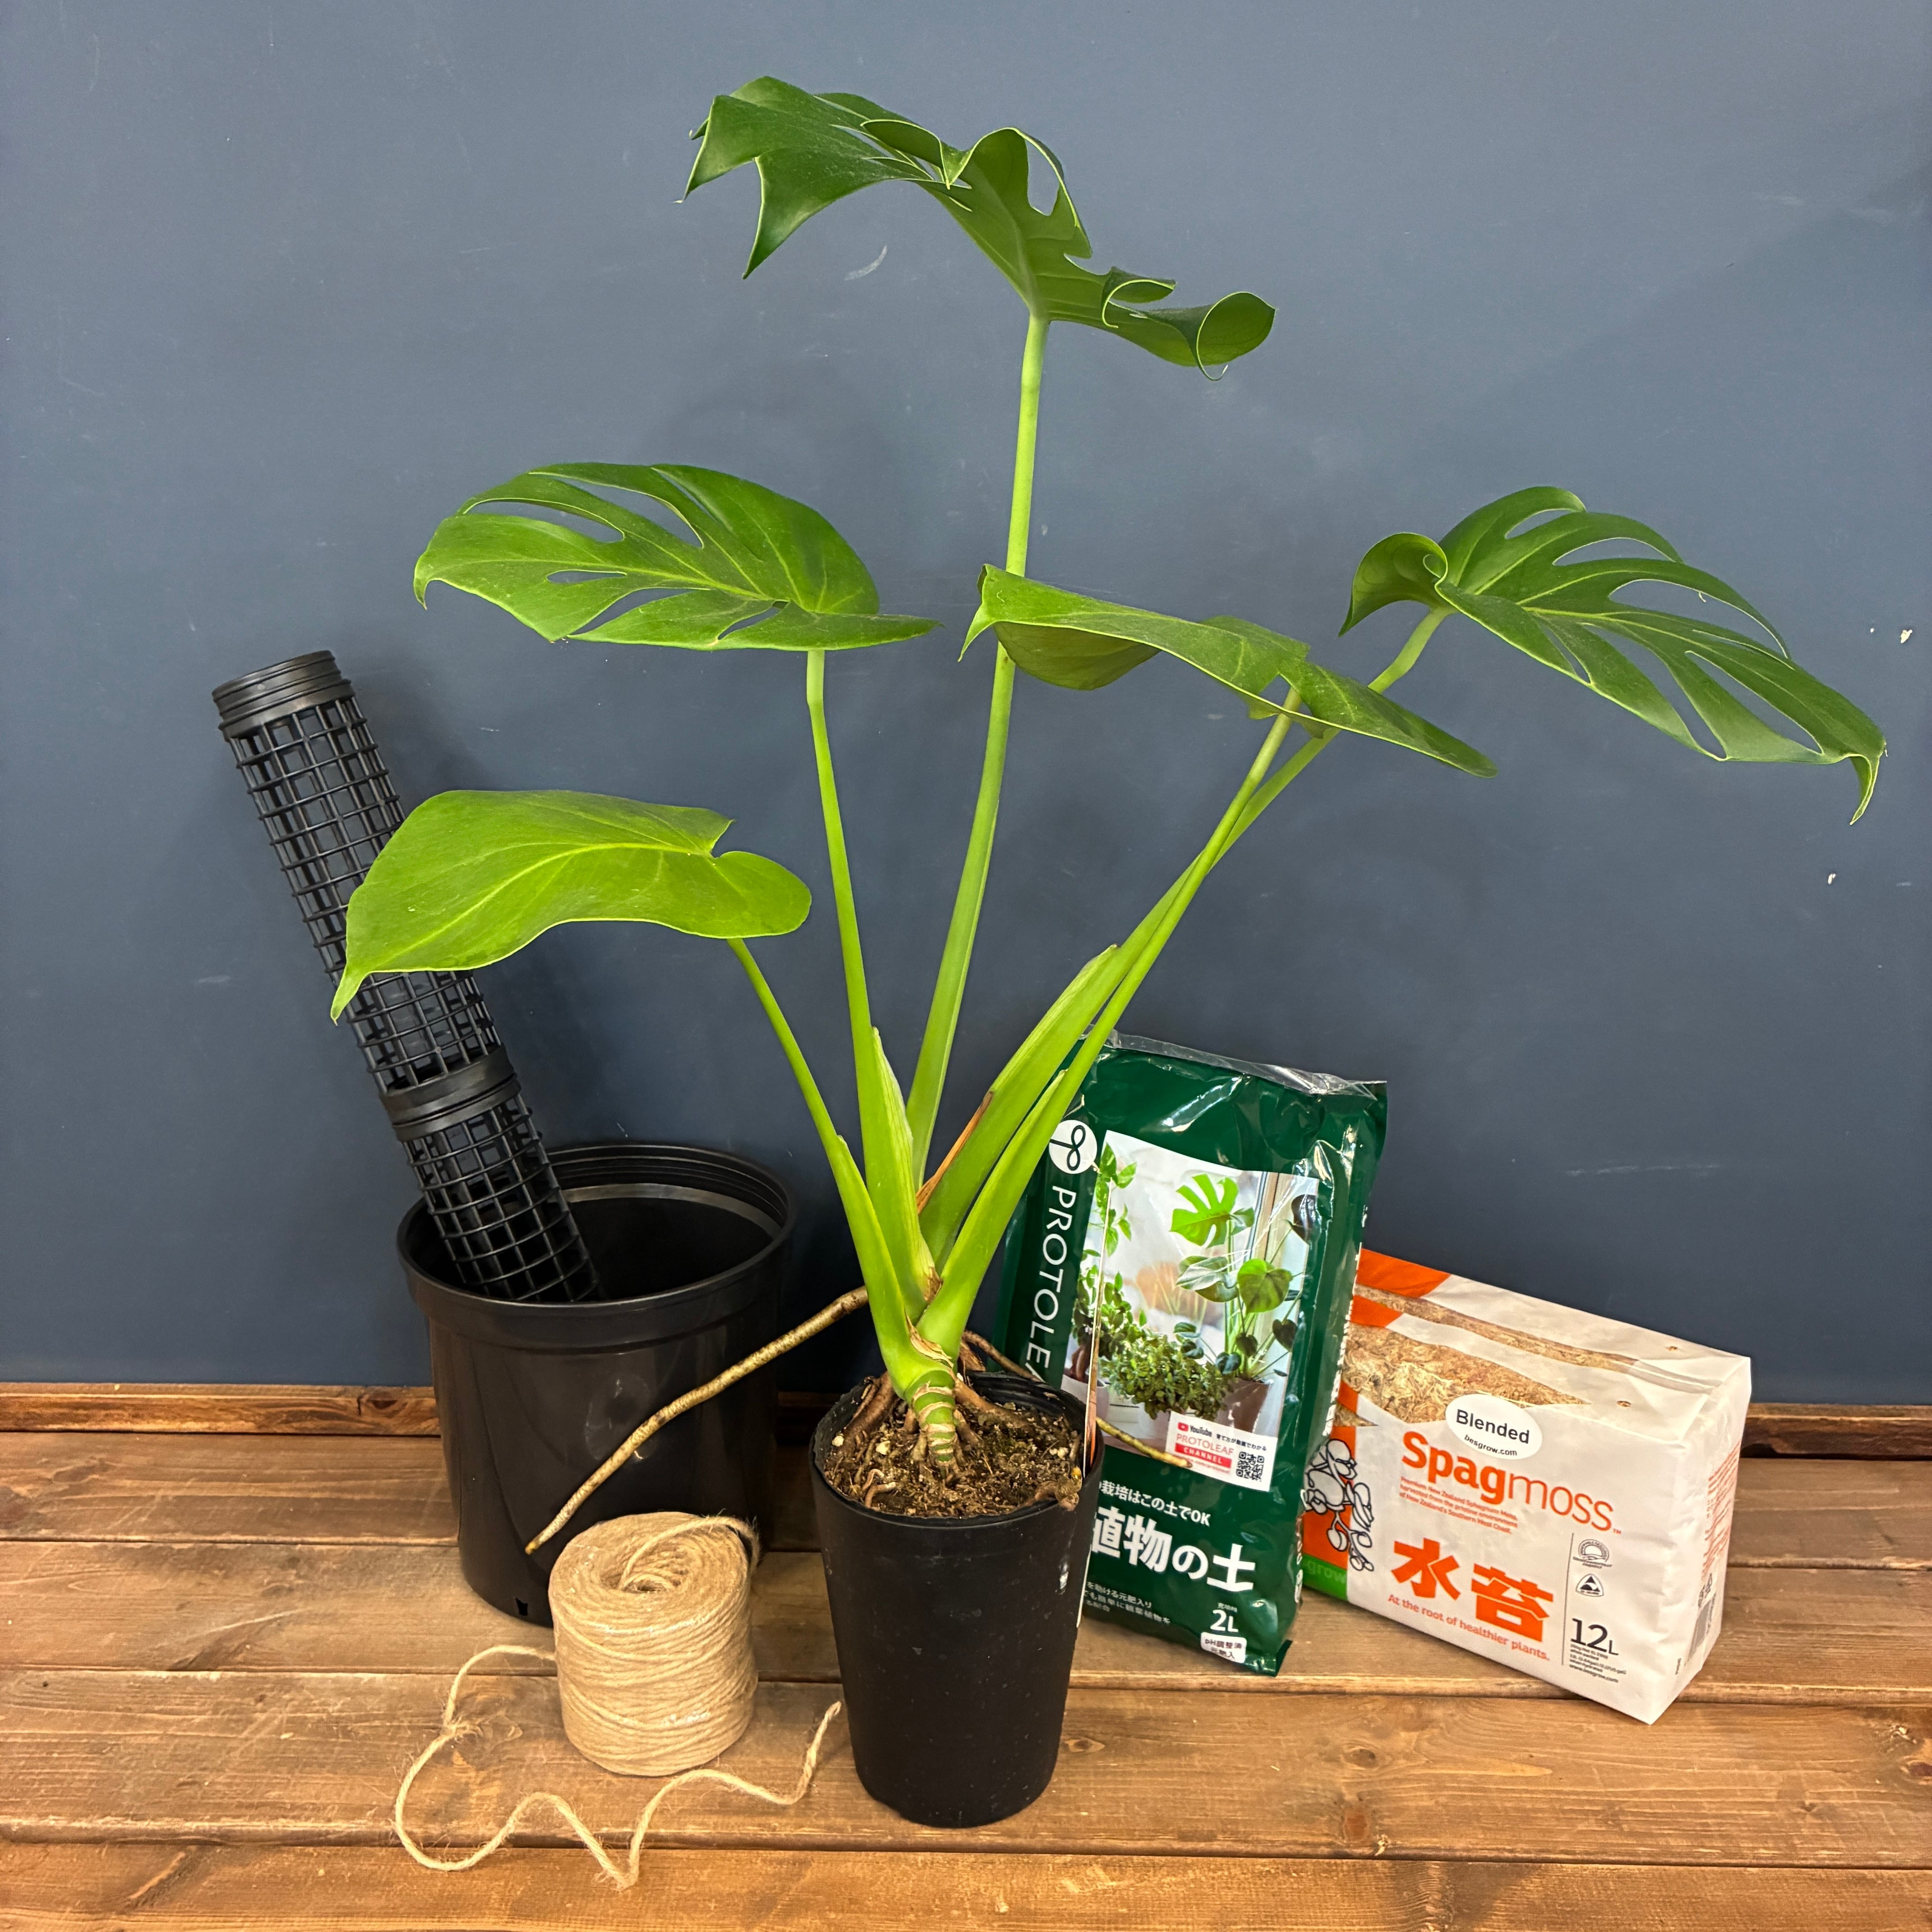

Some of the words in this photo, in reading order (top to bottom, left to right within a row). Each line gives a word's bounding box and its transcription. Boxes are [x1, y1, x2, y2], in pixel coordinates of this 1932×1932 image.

[1177, 1433, 1234, 1455] PROTOLEAF
[1190, 1425, 1212, 1437] YouTube
[1456, 1409, 1529, 1444] Blended
[1183, 1447, 1222, 1464] CHANNEL
[1464, 1434, 1517, 1456] besgrow.com
[1402, 1431, 1613, 1531] Spagmoss
[1099, 1480, 1211, 1527] 栽培はこの土でOK
[1391, 1537, 1554, 1642] 水苔
[1210, 1610, 1238, 1632] 2L
[1389, 1595, 1399, 1603] At
[1403, 1600, 1419, 1612] the
[1422, 1607, 1444, 1622] root
[1446, 1616, 1458, 1626] of
[1459, 1620, 1509, 1645] healthier
[1511, 1640, 1550, 1661] plants.
[1570, 1618, 1619, 1656] 12L
